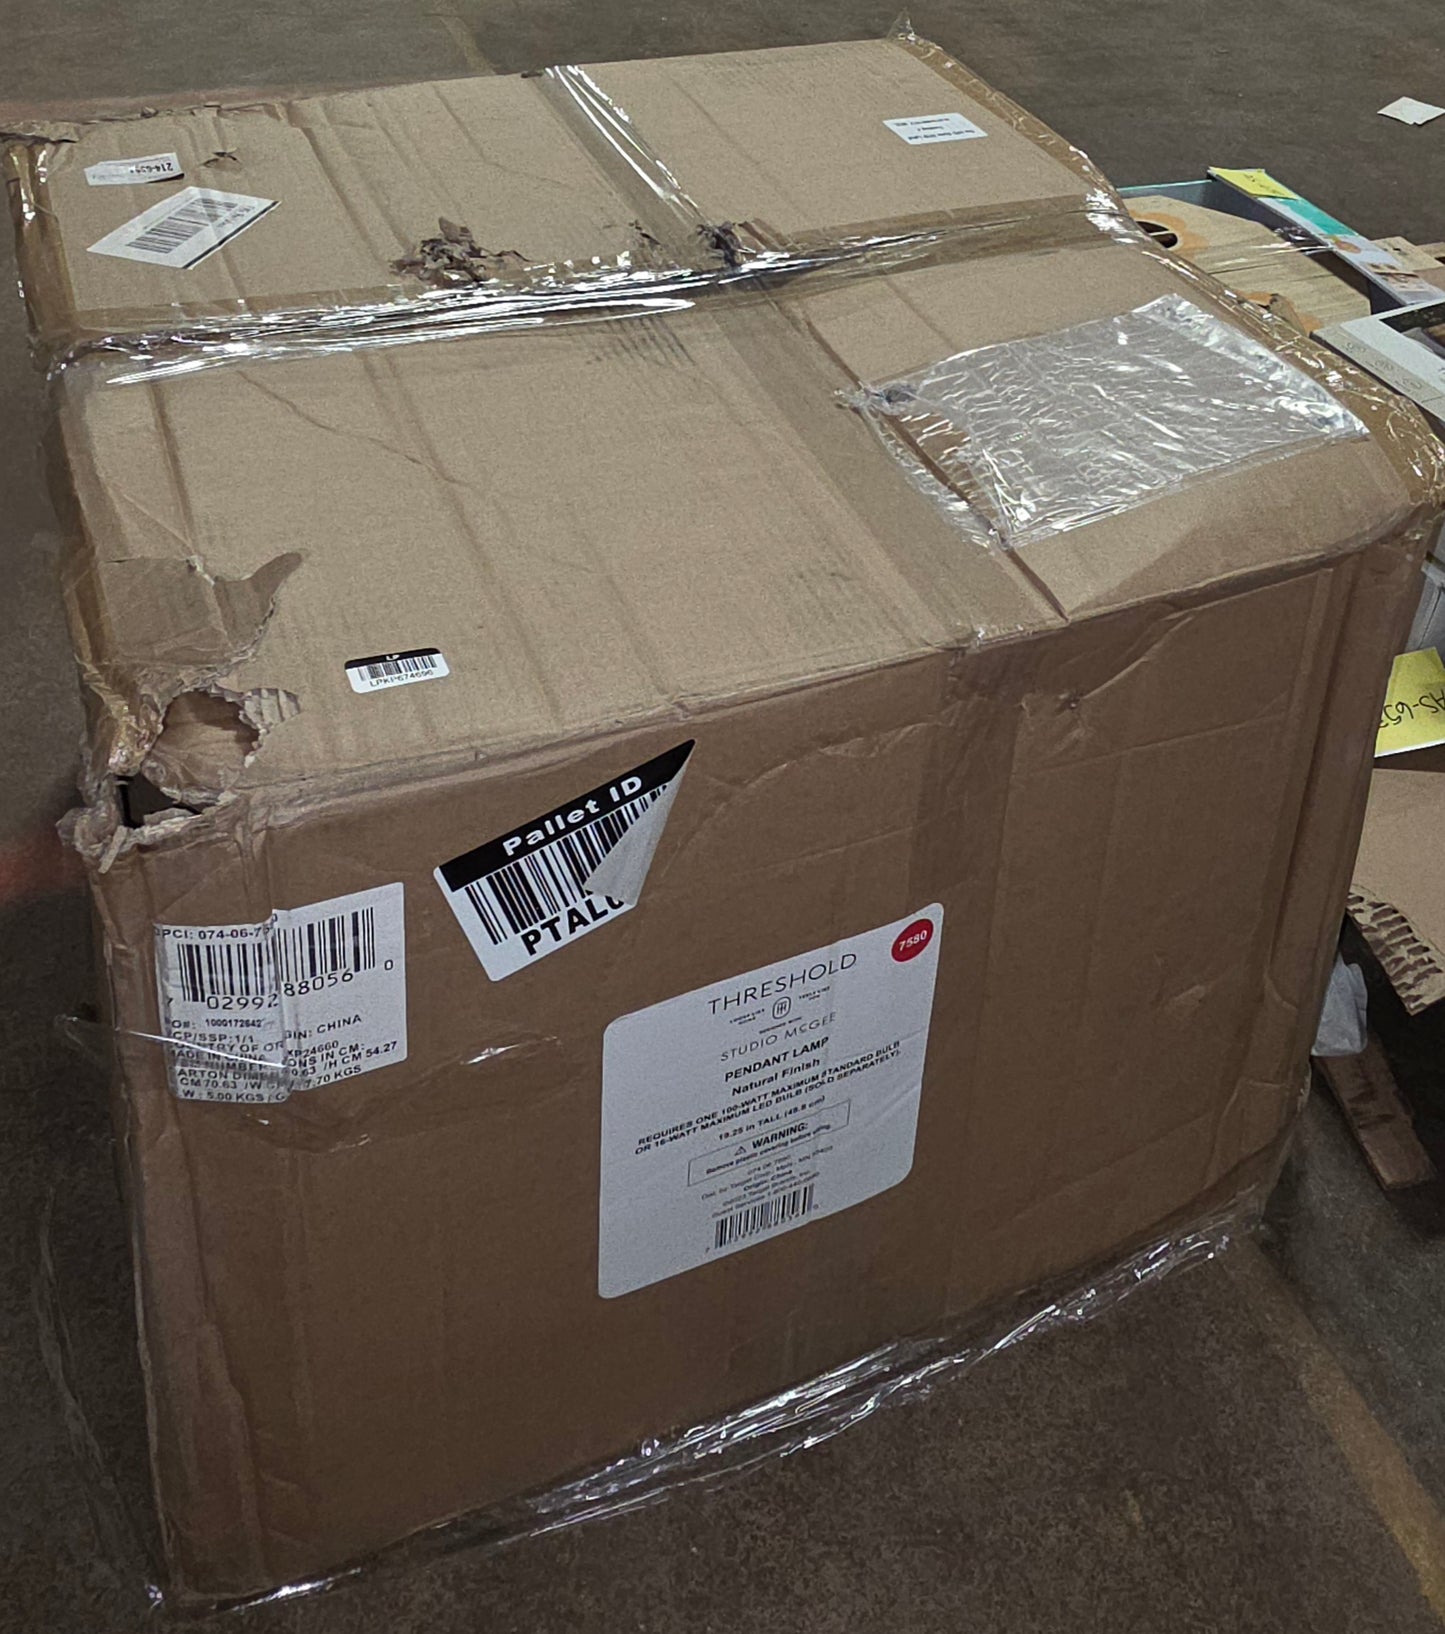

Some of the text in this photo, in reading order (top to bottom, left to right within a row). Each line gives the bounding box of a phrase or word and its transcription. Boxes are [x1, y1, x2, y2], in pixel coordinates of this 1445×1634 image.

[502, 776, 642, 856] Pallet ID
[899, 929, 928, 951] 7580
[206, 993, 279, 1010] 02992
[284, 968, 354, 997] 88056
[384, 959, 394, 971] 0
[708, 953, 857, 1015] THRESHOLD
[316, 1013, 362, 1035] CHINA
[320, 1050, 335, 1061] IN
[341, 1051, 362, 1064] CM
[365, 1041, 397, 1059] 54.27
[720, 1034, 778, 1062] STUDIO
[724, 1036, 830, 1083] PENDANT LAMP
[236, 1090, 265, 1102] KGS
[333, 1064, 362, 1079] KGS
[731, 1058, 821, 1096] Natural Finish
[638, 1120, 694, 1146] REQUIRES
[695, 1111, 719, 1126] ONE
[770, 1074, 820, 1099] MAXIMUM
[821, 1053, 875, 1080] STANDARD
[634, 1144, 652, 1156] OR
[700, 1108, 751, 1133] MAXIMUM
[752, 1099, 774, 1114] LED
[775, 1086, 803, 1106] BULB
[751, 1122, 809, 1150] WARNING:
[757, 1111, 783, 1128] TALL
